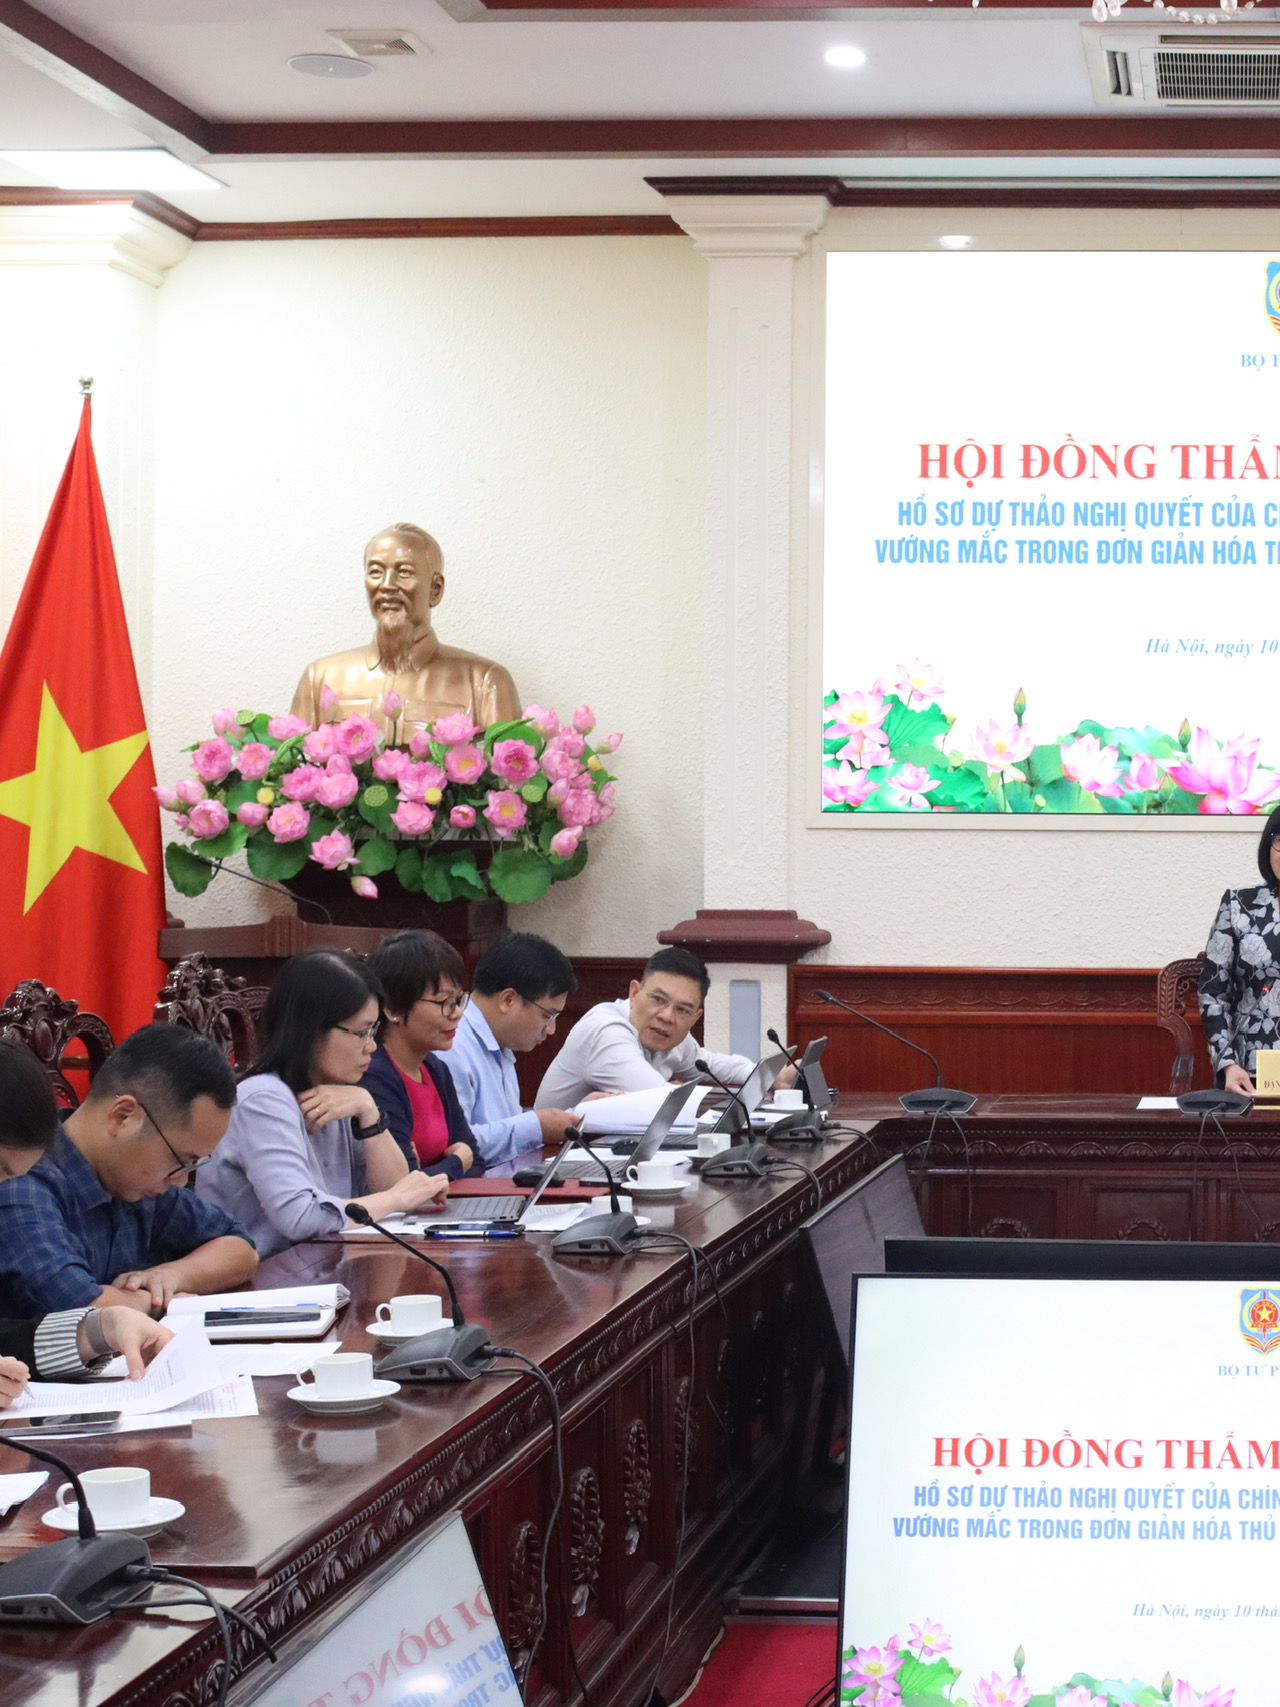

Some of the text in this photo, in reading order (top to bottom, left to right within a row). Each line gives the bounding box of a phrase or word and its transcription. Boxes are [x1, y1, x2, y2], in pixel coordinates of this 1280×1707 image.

[1240, 352, 1265, 371] BỘ
[917, 438, 1005, 489] HỘI
[1018, 433, 1158, 480] ĐỒNG
[898, 493, 927, 526] HỒ
[935, 499, 965, 527] SƠ
[972, 499, 1004, 532] DỰ
[1008, 493, 1065, 527] THẢO
[1073, 501, 1127, 532] NGHỊ
[1135, 494, 1204, 530] QUYẾT
[1211, 494, 1257, 527] CỦA
[875, 534, 950, 563] VƯỚNG
[957, 530, 1008, 564] MẮC
[1015, 540, 1089, 564] TRONG
[1096, 537, 1143, 565] ĐƠN
[1151, 532, 1204, 564] GIẢN
[1212, 535, 1257, 565] HÓA
[1145, 638, 1170, 653] Hà
[1175, 638, 1209, 657] Nội,
[1215, 640, 1254, 658] ngày
[1260, 640, 1279, 654] 10
[1218, 1364, 1239, 1380] BỘ
[1243, 1364, 1267, 1377] TƯ
[931, 1433, 1010, 1475] HỘI
[1021, 1429, 1145, 1469] ĐỒNG
[914, 1479, 940, 1507] HỒ
[947, 1484, 974, 1507] SƠ
[980, 1484, 1008, 1512] DỰ
[1012, 1480, 1062, 1508] THẢO
[1070, 1487, 1117, 1513] NGHỊ
[1124, 1482, 1185, 1511] QUYẾT
[1192, 1482, 1231, 1509] CỦA
[893, 1513, 959, 1538] VƯỚNG
[966, 1510, 1011, 1538] MẮC
[1018, 1519, 1083, 1539] TRONG
[1090, 1518, 1130, 1539] ĐƠN
[1138, 1513, 1185, 1540] GIẢN
[1193, 1516, 1232, 1540] HÓA
[1239, 1514, 1275, 1541] THỦ
[1132, 1603, 1154, 1616] Hà
[1159, 1604, 1189, 1619] Nội,
[1194, 1605, 1229, 1620] ngày
[1235, 1604, 1251, 1617] 10
